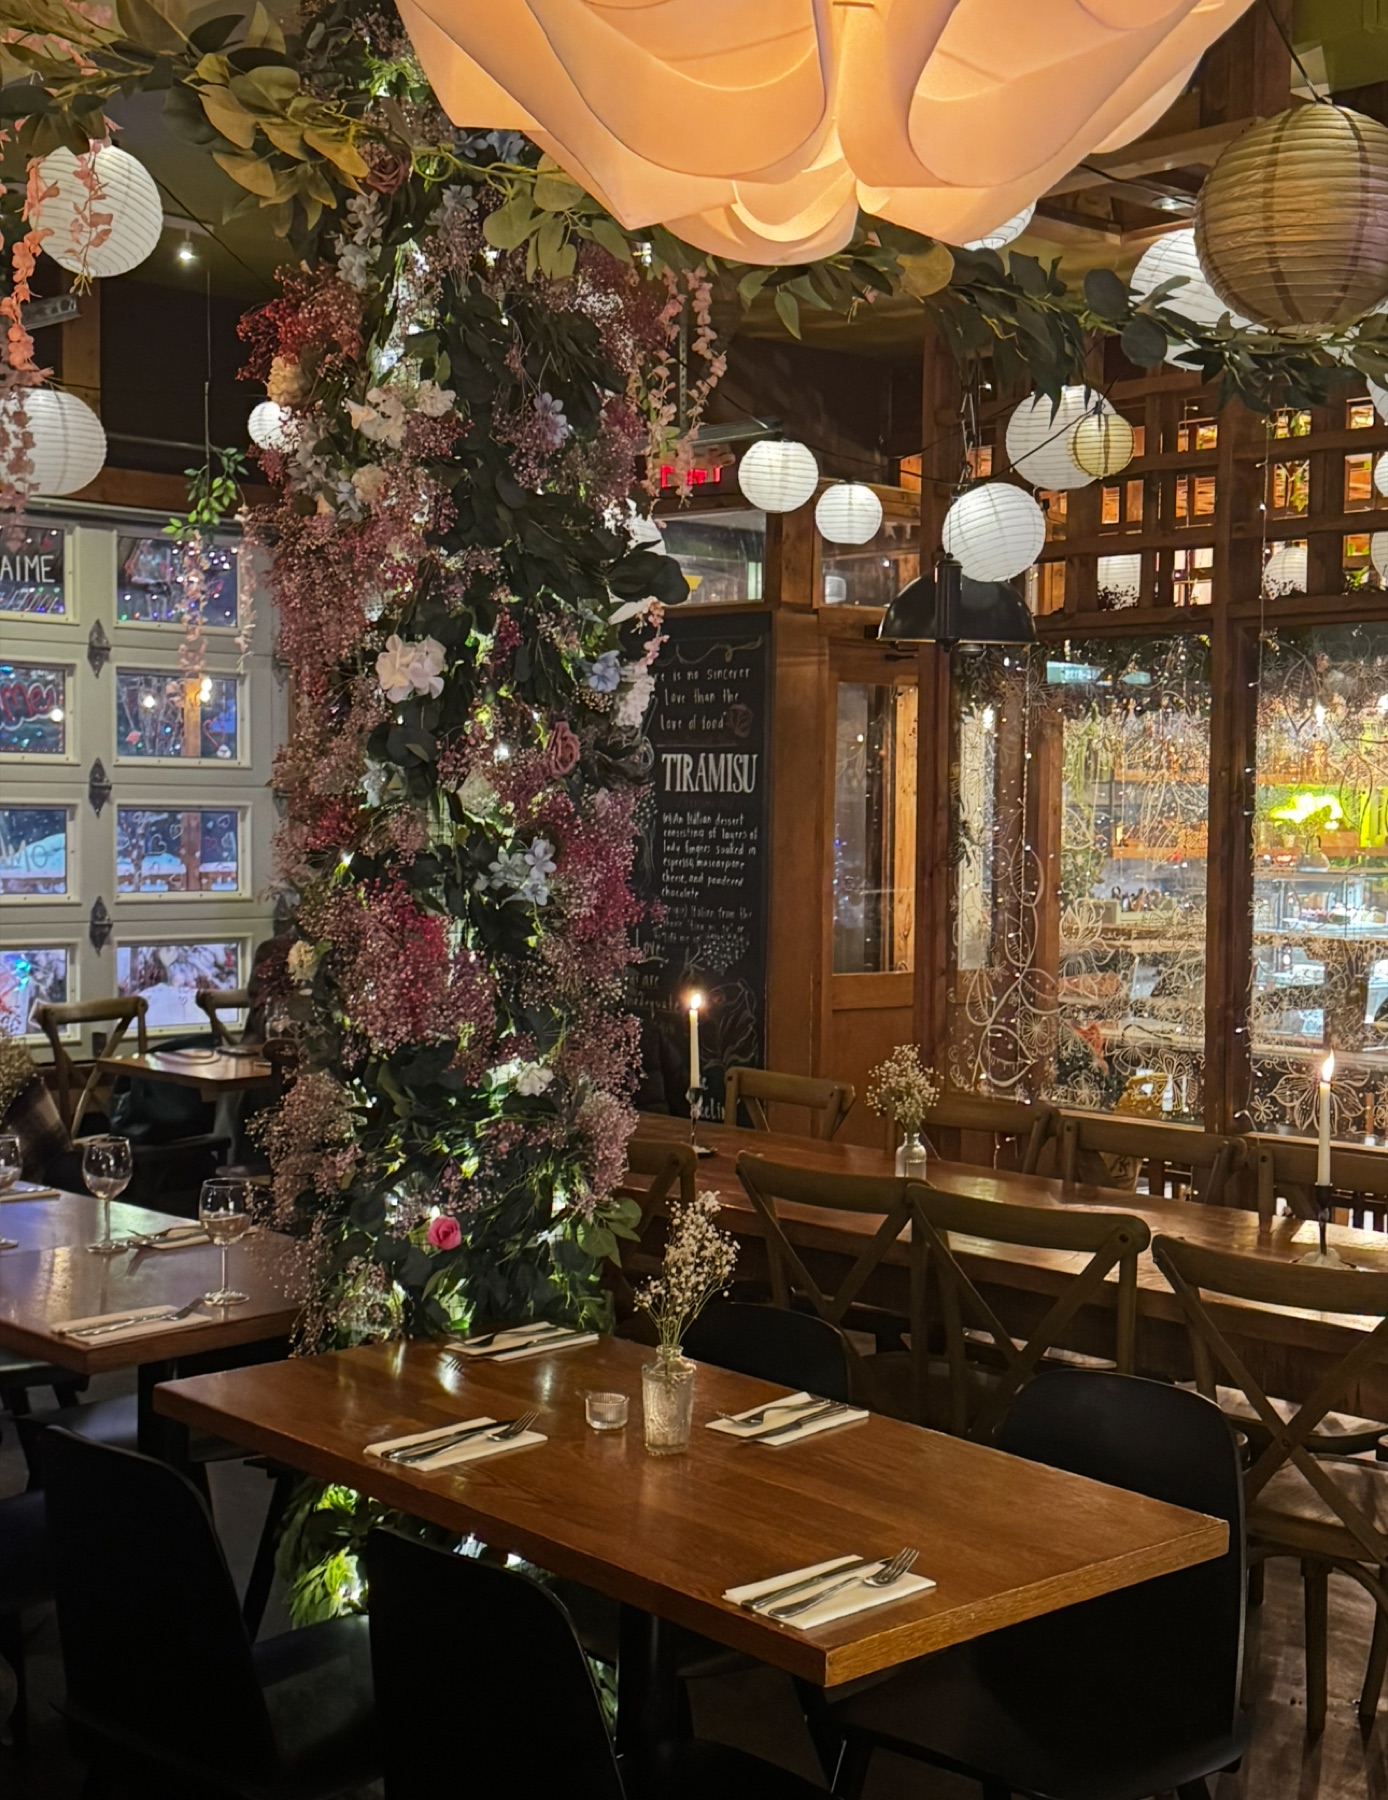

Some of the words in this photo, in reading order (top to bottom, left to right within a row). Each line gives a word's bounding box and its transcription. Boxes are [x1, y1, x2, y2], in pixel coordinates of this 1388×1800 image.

[0, 554, 56, 583] AIME
[672, 670, 682, 682] is
[686, 669, 699, 681] no
[693, 687, 716, 704] than
[722, 687, 739, 704] the
[688, 713, 697, 731] of
[661, 752, 759, 794] TIRAMISU
[714, 812, 744, 826] dessert
[663, 827, 705, 841] consisting
[708, 826, 717, 839] of
[721, 827, 748, 844] layers
[749, 826, 758, 840] of
[715, 842, 745, 855] soaked
[707, 874, 744, 888] powdered
[661, 884, 699, 900] chocolate
